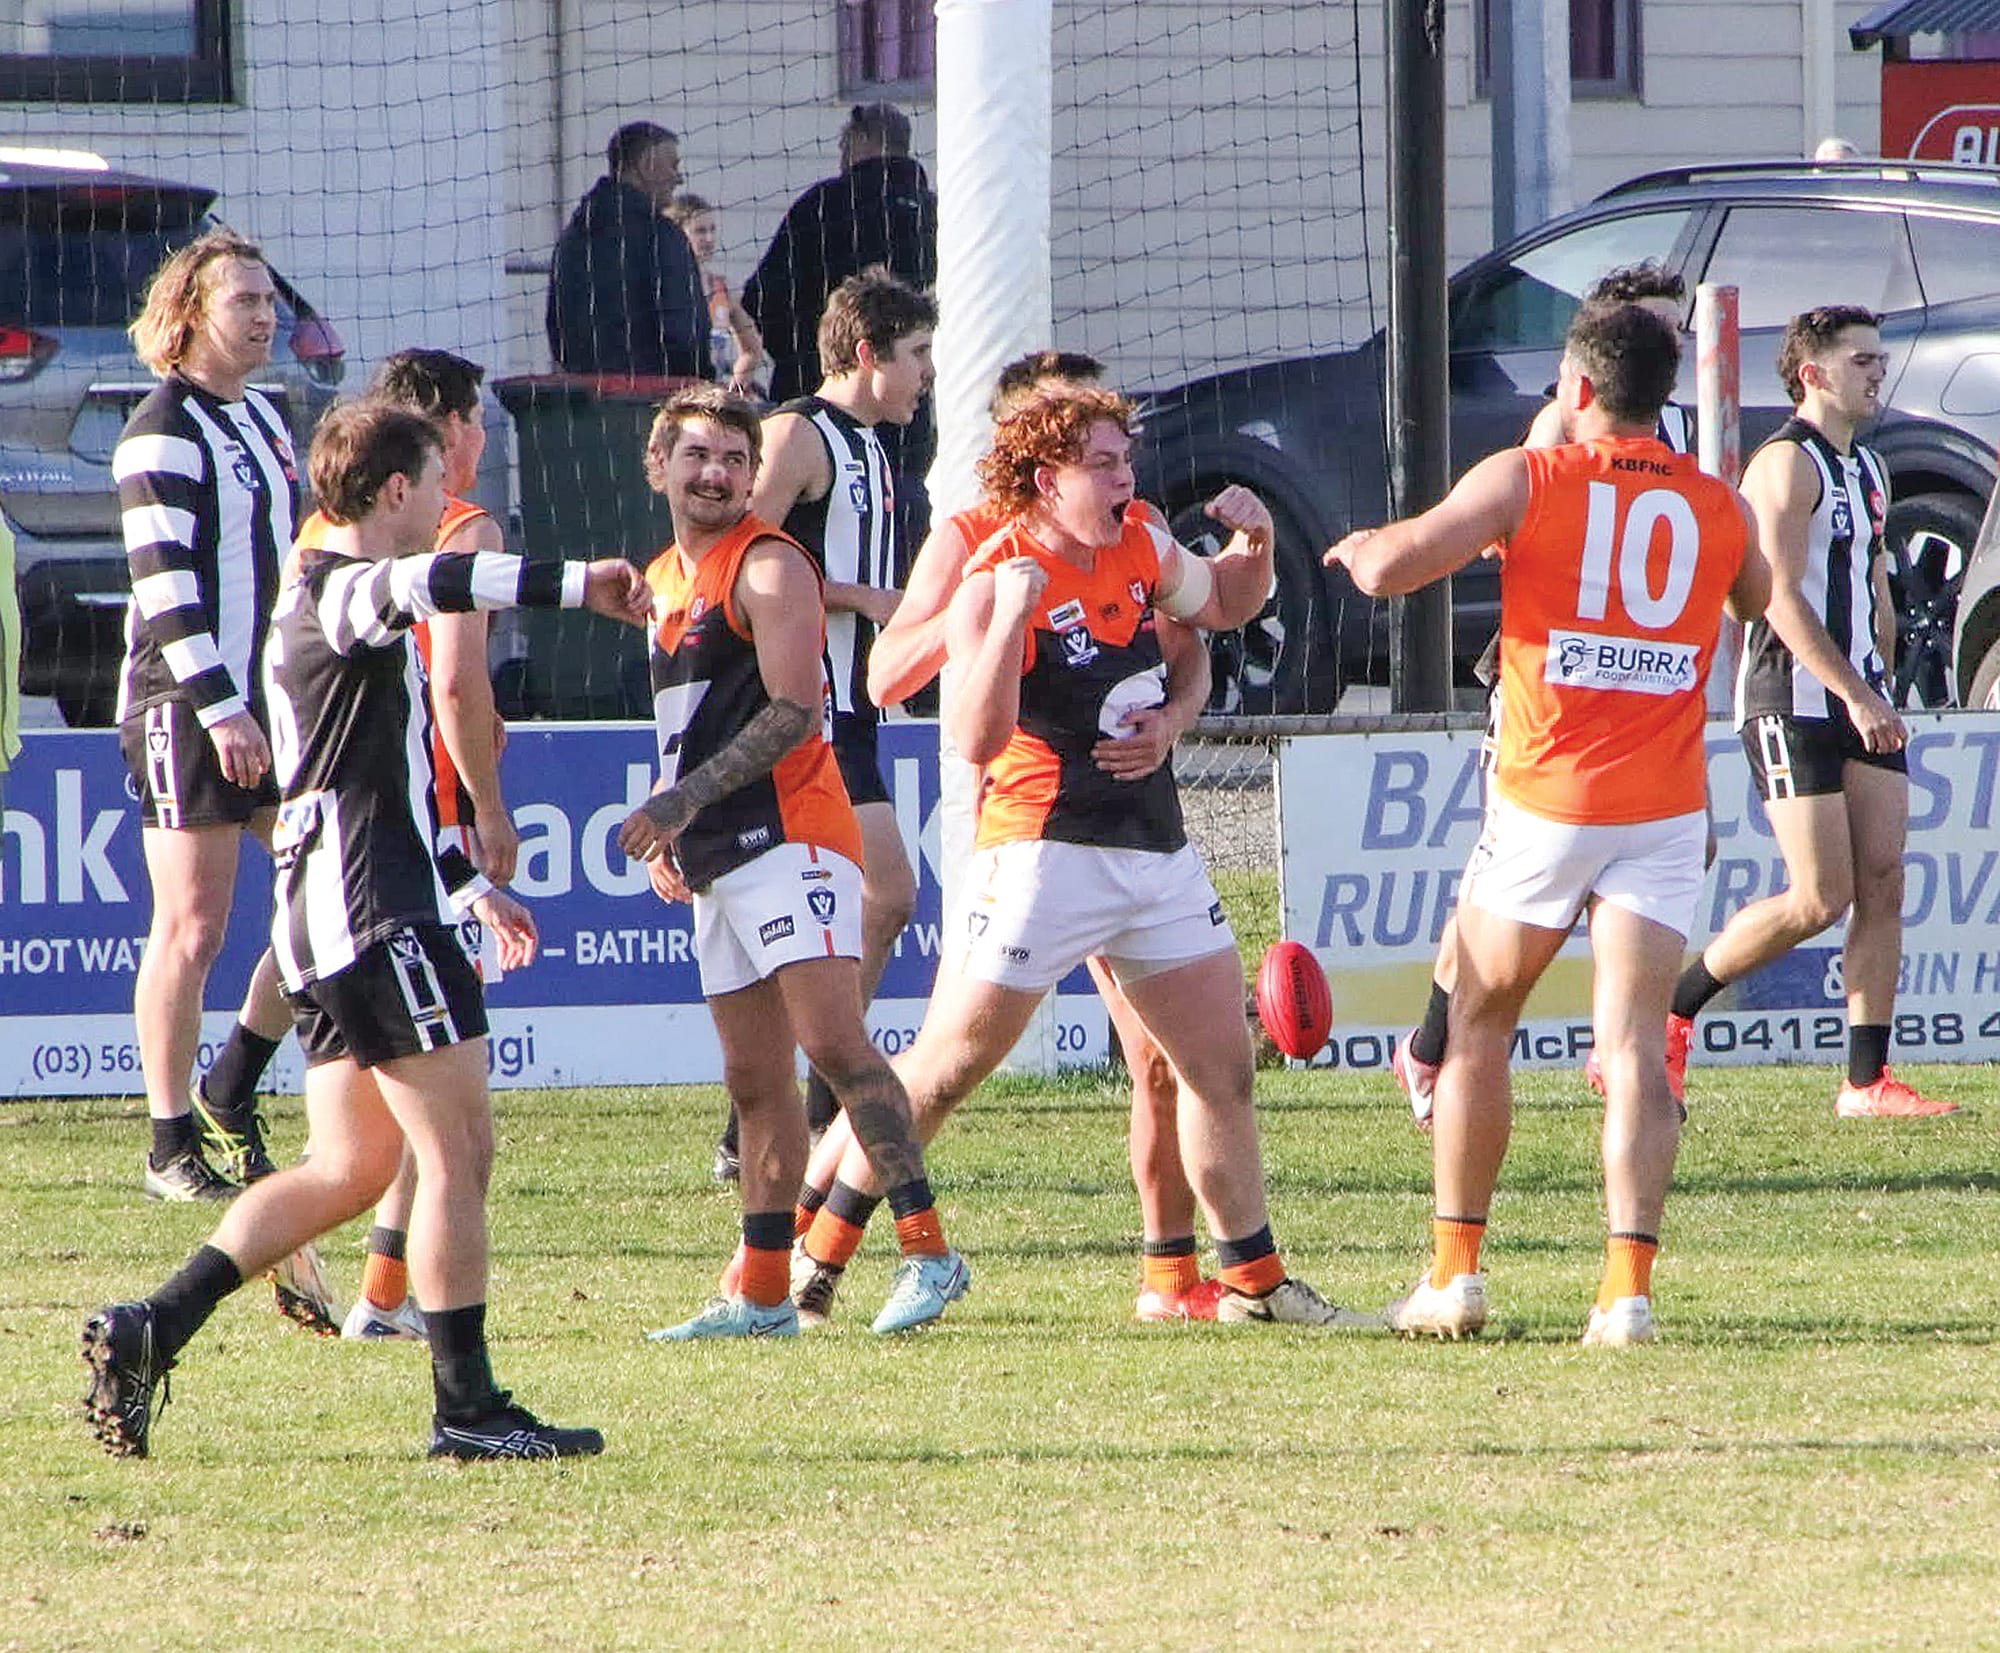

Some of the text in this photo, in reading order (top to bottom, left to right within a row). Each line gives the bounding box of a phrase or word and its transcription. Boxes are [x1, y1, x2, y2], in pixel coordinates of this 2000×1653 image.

[1612, 458, 1674, 476] KBFNC
[1577, 480, 1700, 629] 10
[1598, 645, 1690, 676] BURRA
[1361, 748, 1487, 850] BA
[0, 939, 72, 974] HOT
[1703, 1015, 1844, 1052] 0412
[33, 1045, 91, 1080] (03)
